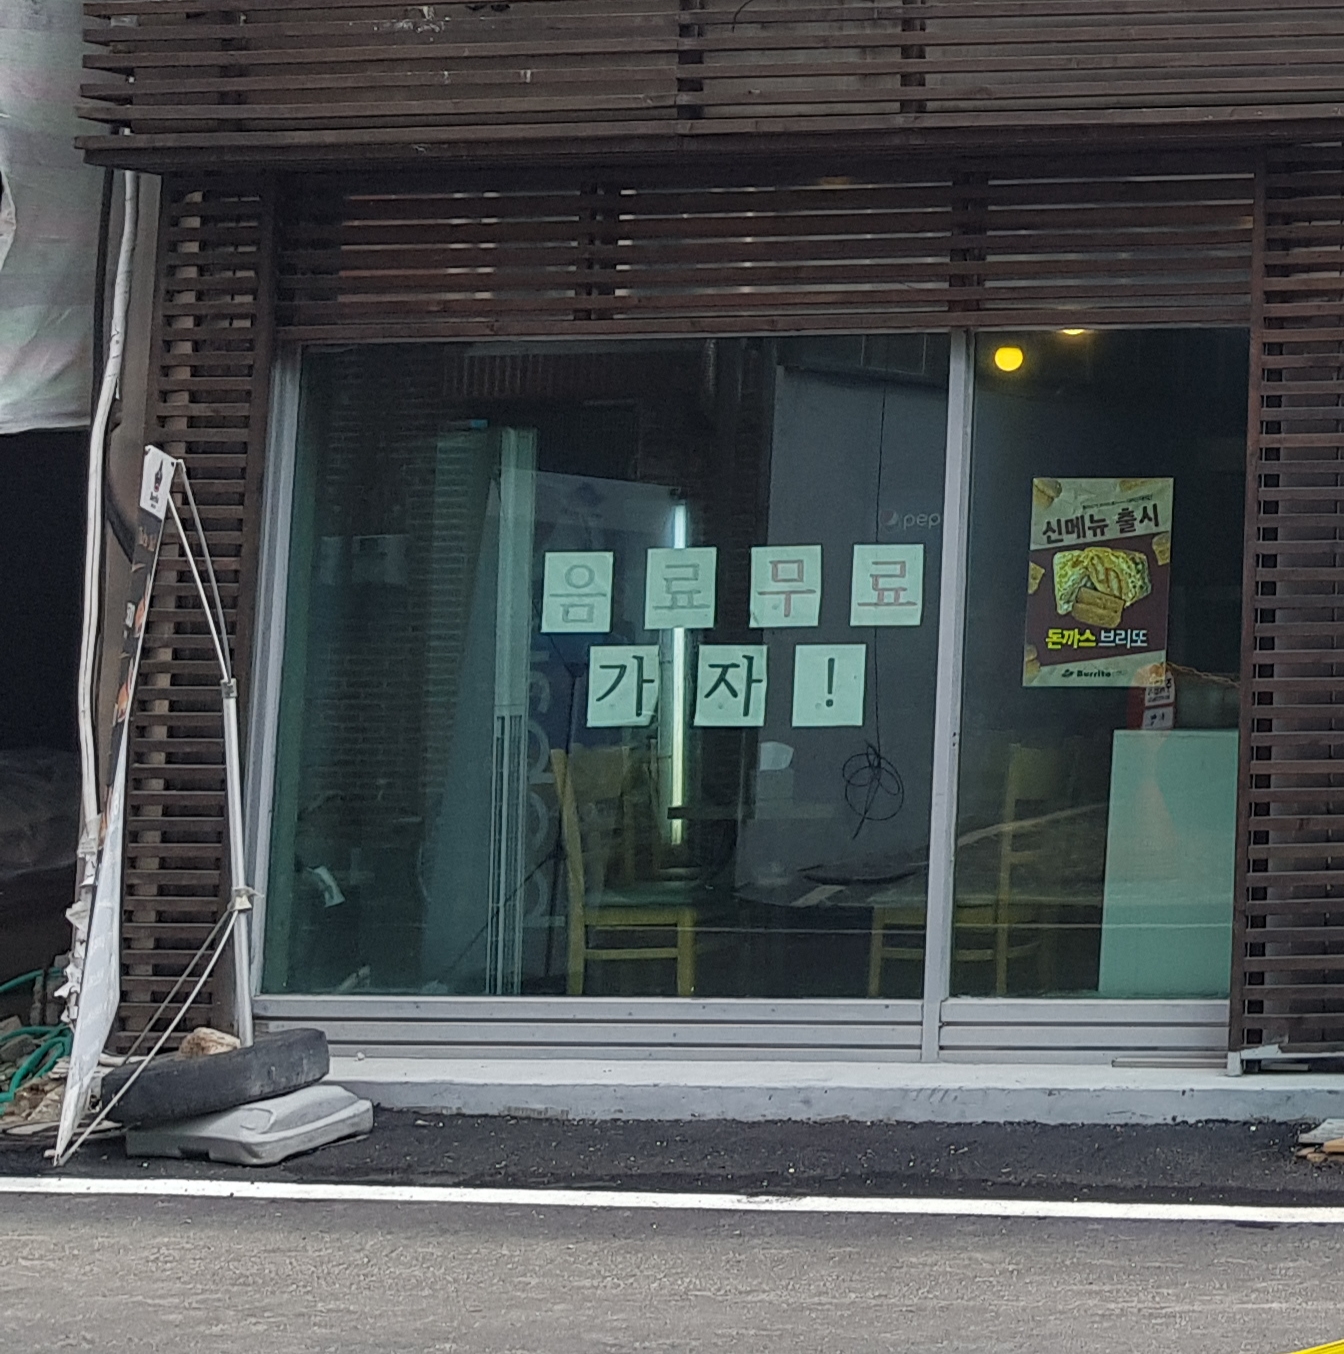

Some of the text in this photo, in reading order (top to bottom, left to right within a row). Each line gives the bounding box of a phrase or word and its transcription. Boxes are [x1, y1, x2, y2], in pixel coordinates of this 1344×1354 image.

[903, 513, 941, 530] pep
[1042, 503, 1159, 544] 신메뉴 출시
[1045, 628, 1148, 649] 돈까스 브리또
